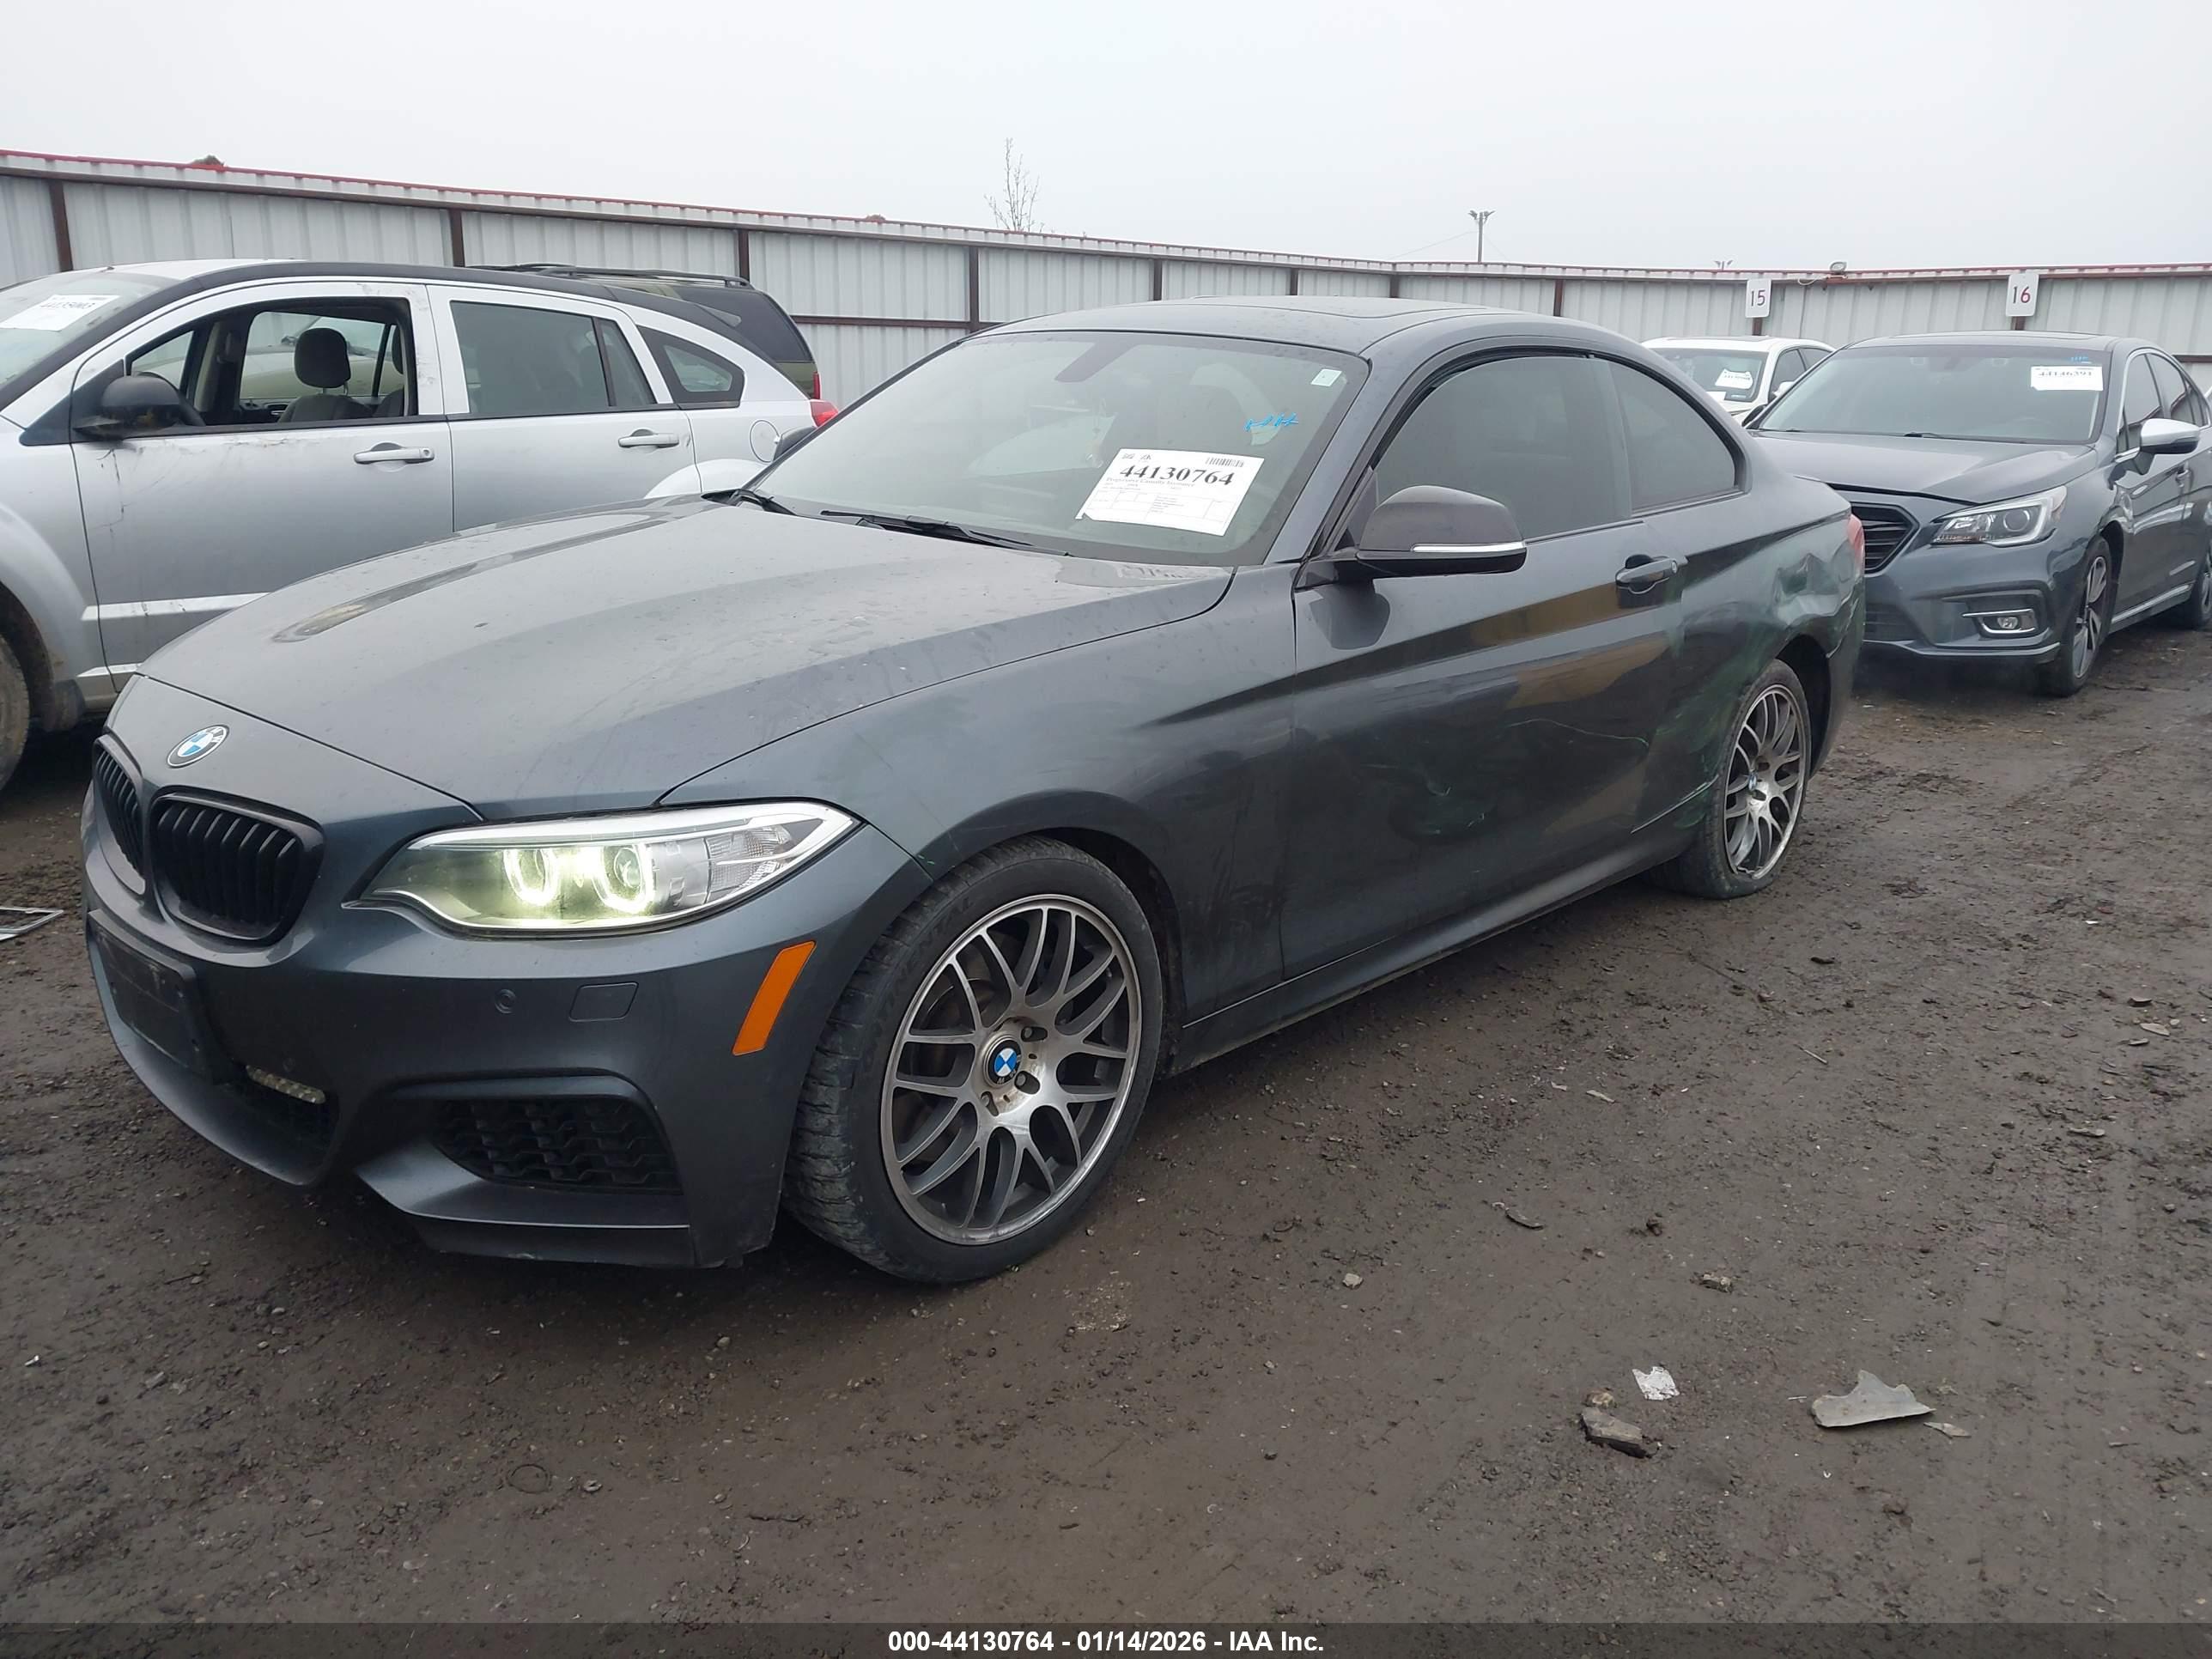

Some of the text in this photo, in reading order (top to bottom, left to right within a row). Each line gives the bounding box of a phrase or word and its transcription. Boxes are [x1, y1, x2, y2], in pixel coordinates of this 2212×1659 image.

[1751, 289, 1766, 307] 15
[2013, 286, 2031, 304] 16
[1120, 465, 1236, 486] 44130764
